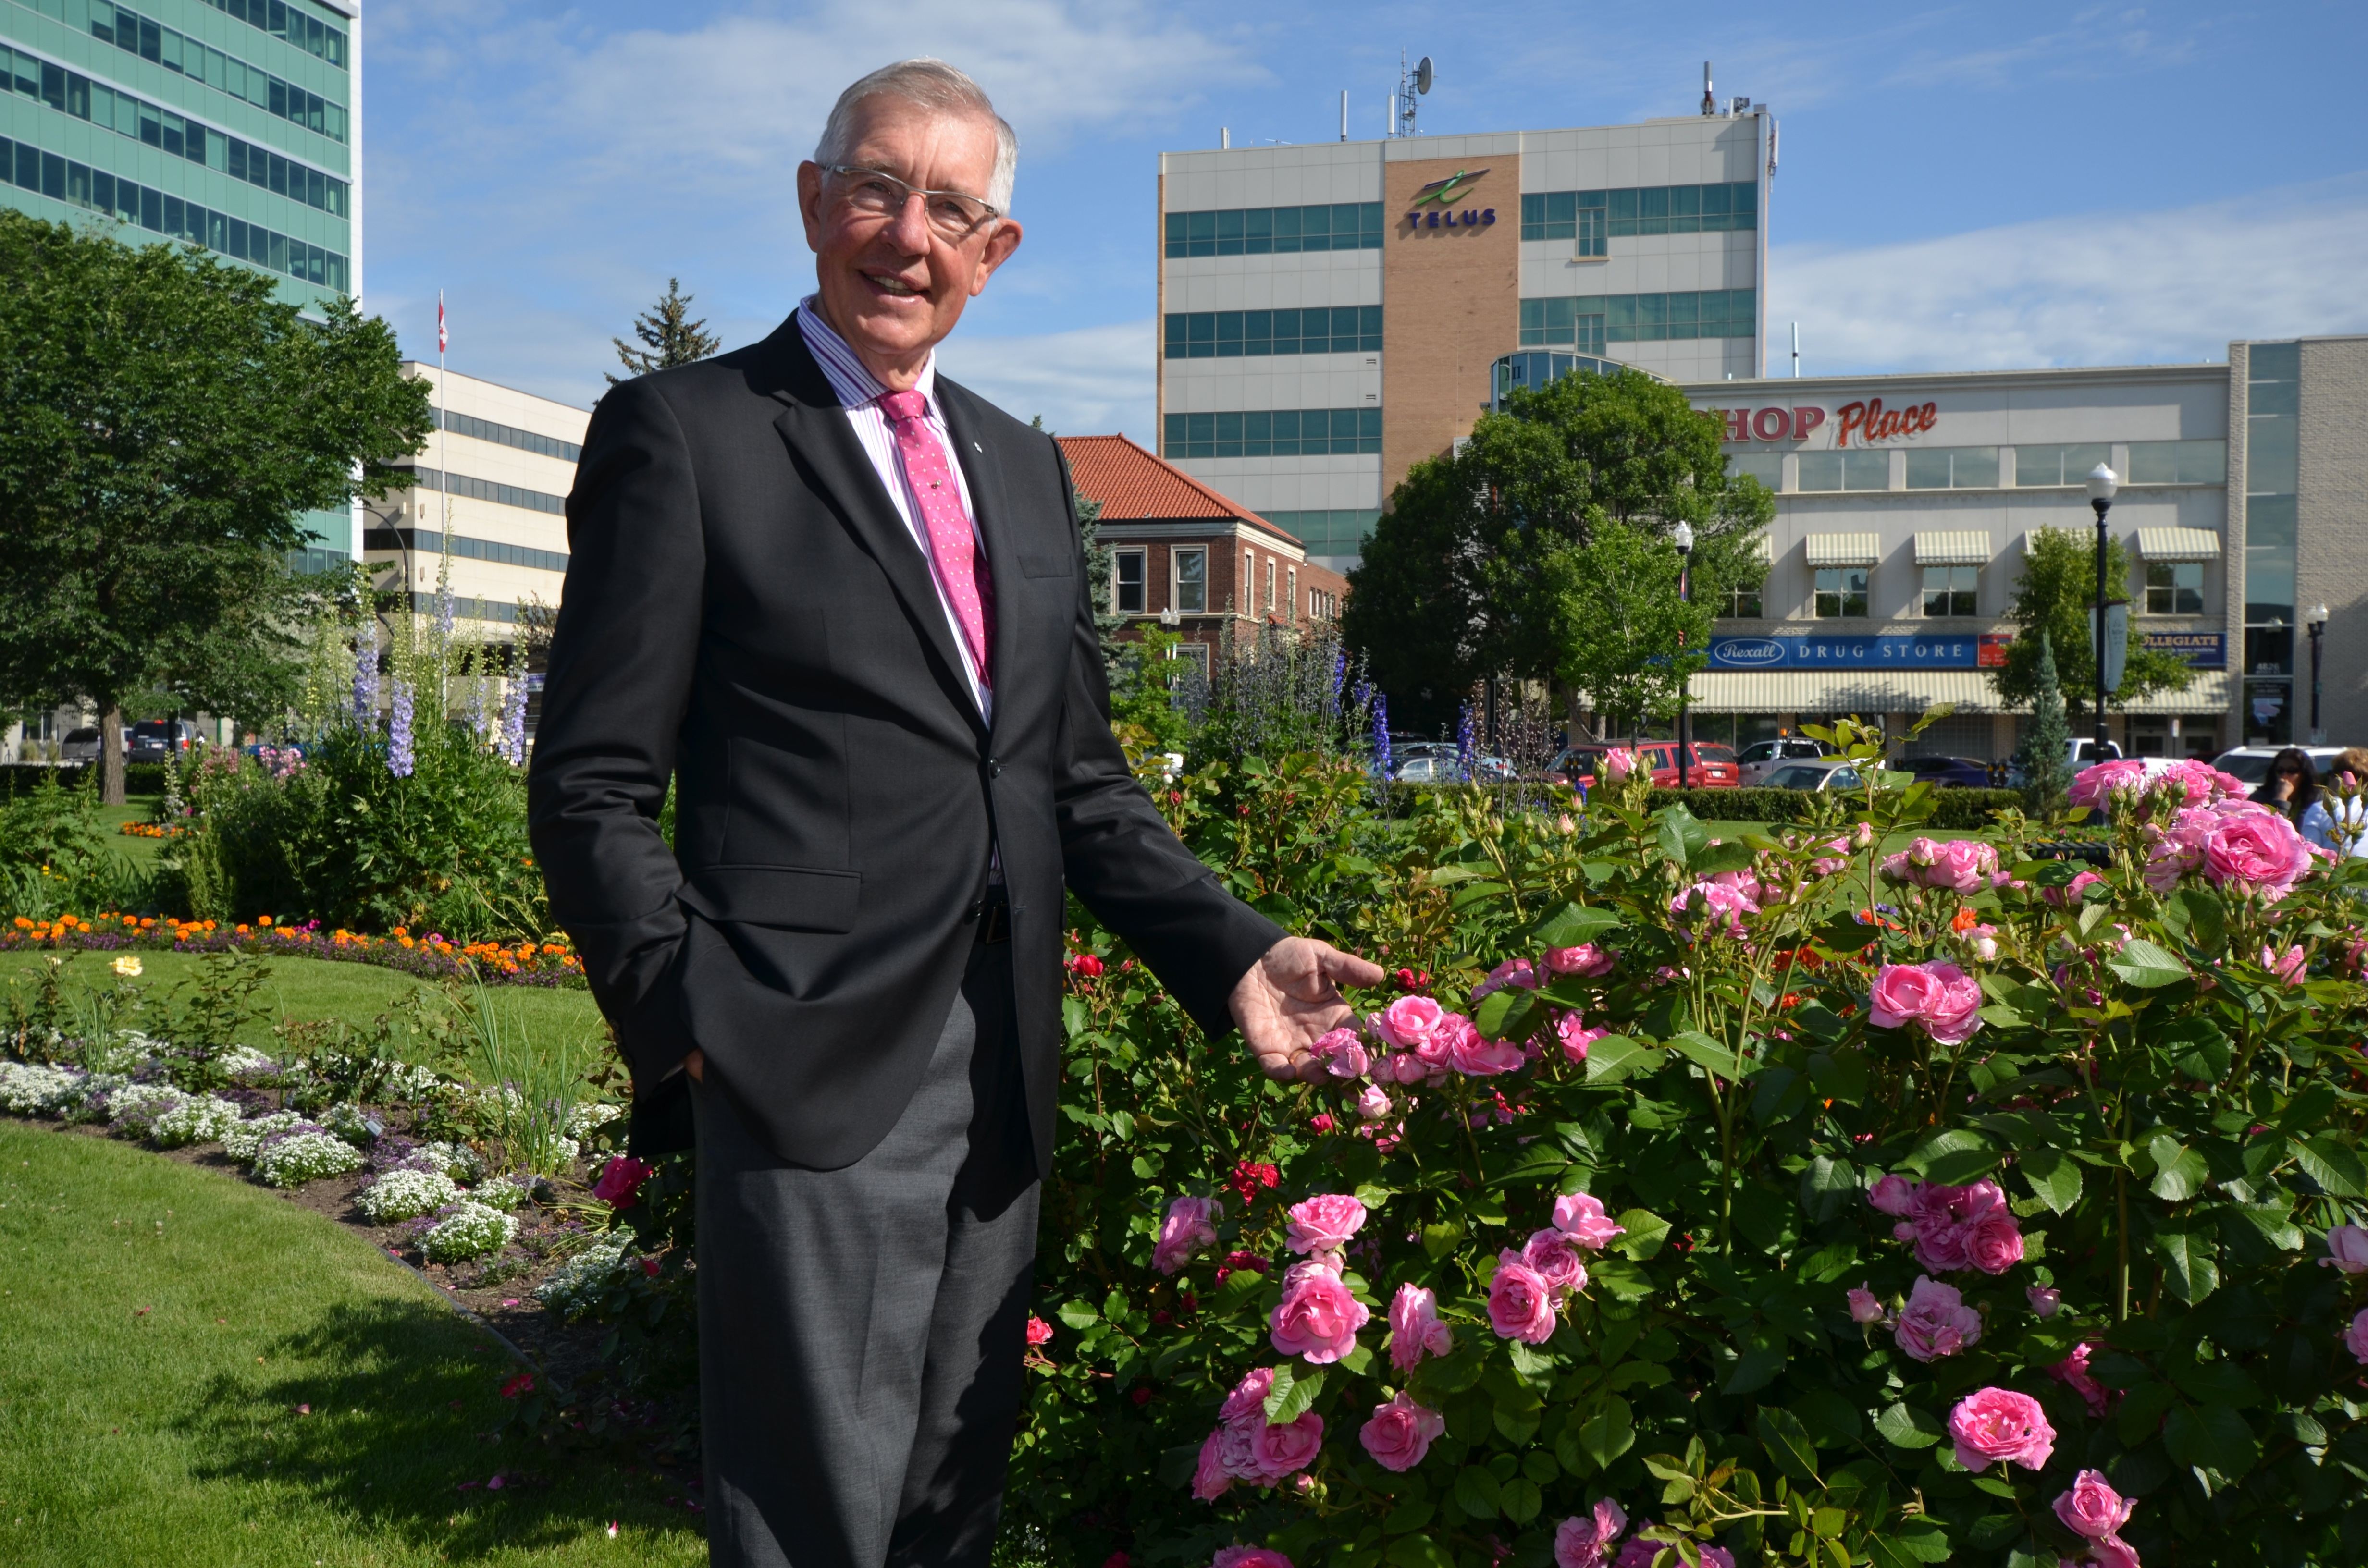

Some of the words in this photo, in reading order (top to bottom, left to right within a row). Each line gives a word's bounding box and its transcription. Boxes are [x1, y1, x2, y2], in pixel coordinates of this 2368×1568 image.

[1408, 208, 1496, 228] TELUS
[1694, 407, 1825, 441] HOP
[1837, 398, 1939, 447] Place
[1723, 644, 1776, 658] Rexall
[1799, 645, 1864, 658] DRUG
[1883, 644, 1962, 658] STORE
